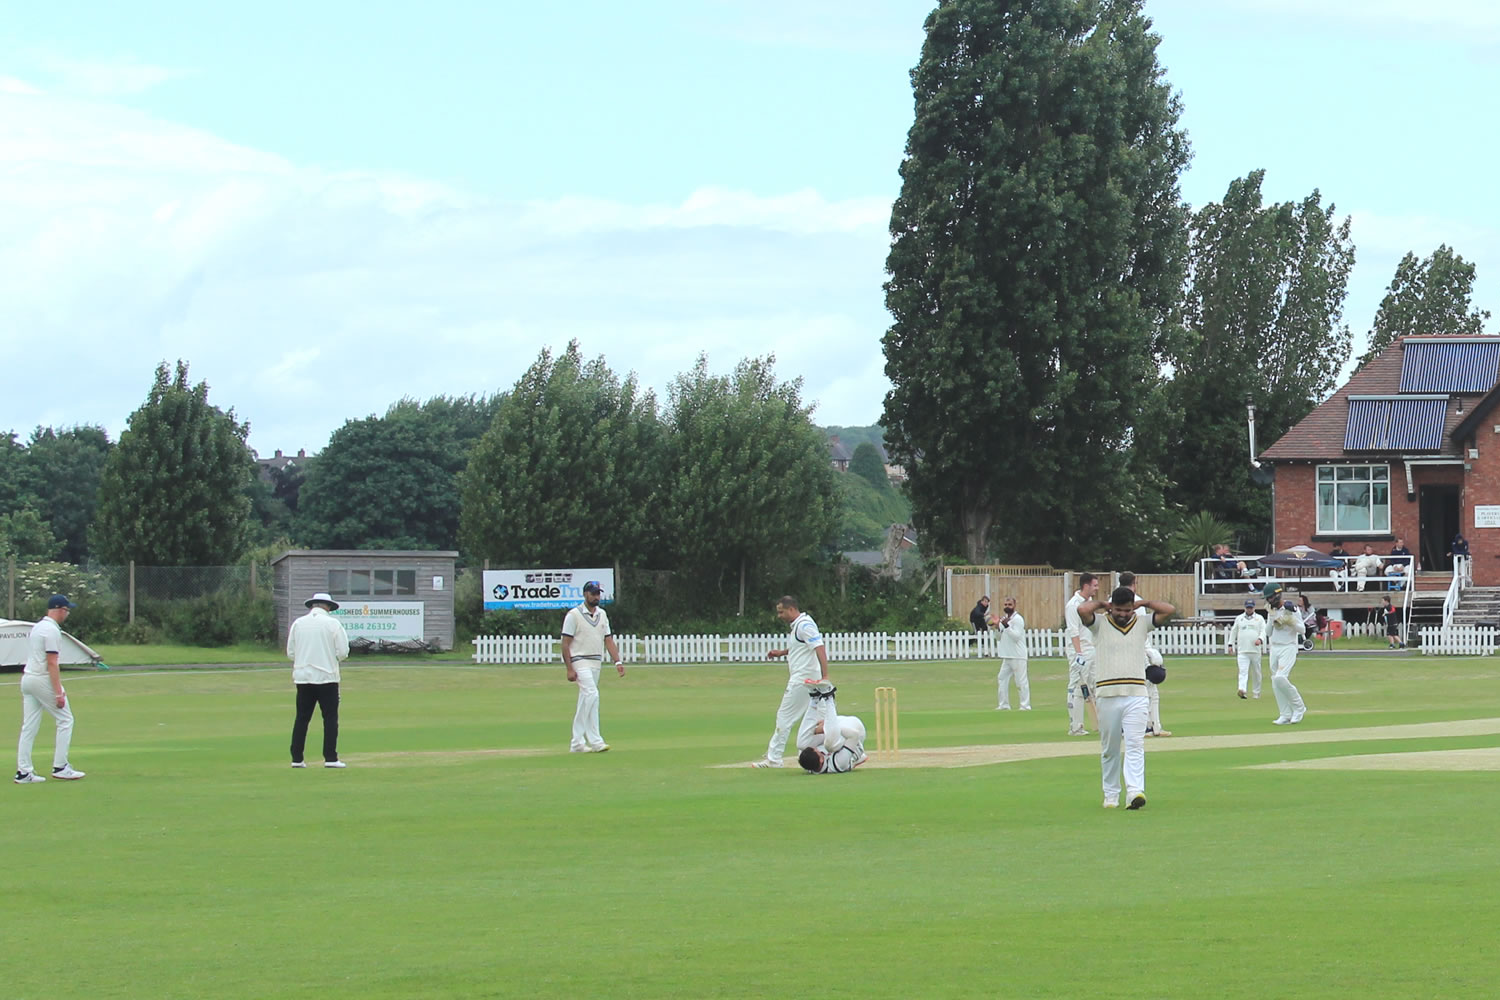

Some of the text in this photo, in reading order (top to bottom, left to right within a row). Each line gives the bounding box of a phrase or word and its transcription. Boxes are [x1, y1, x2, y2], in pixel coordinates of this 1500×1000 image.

[511, 584, 584, 599] TradeTru
[514, 601, 579, 609] www.tradetrux.co.uk
[366, 622, 396, 630] 263192
